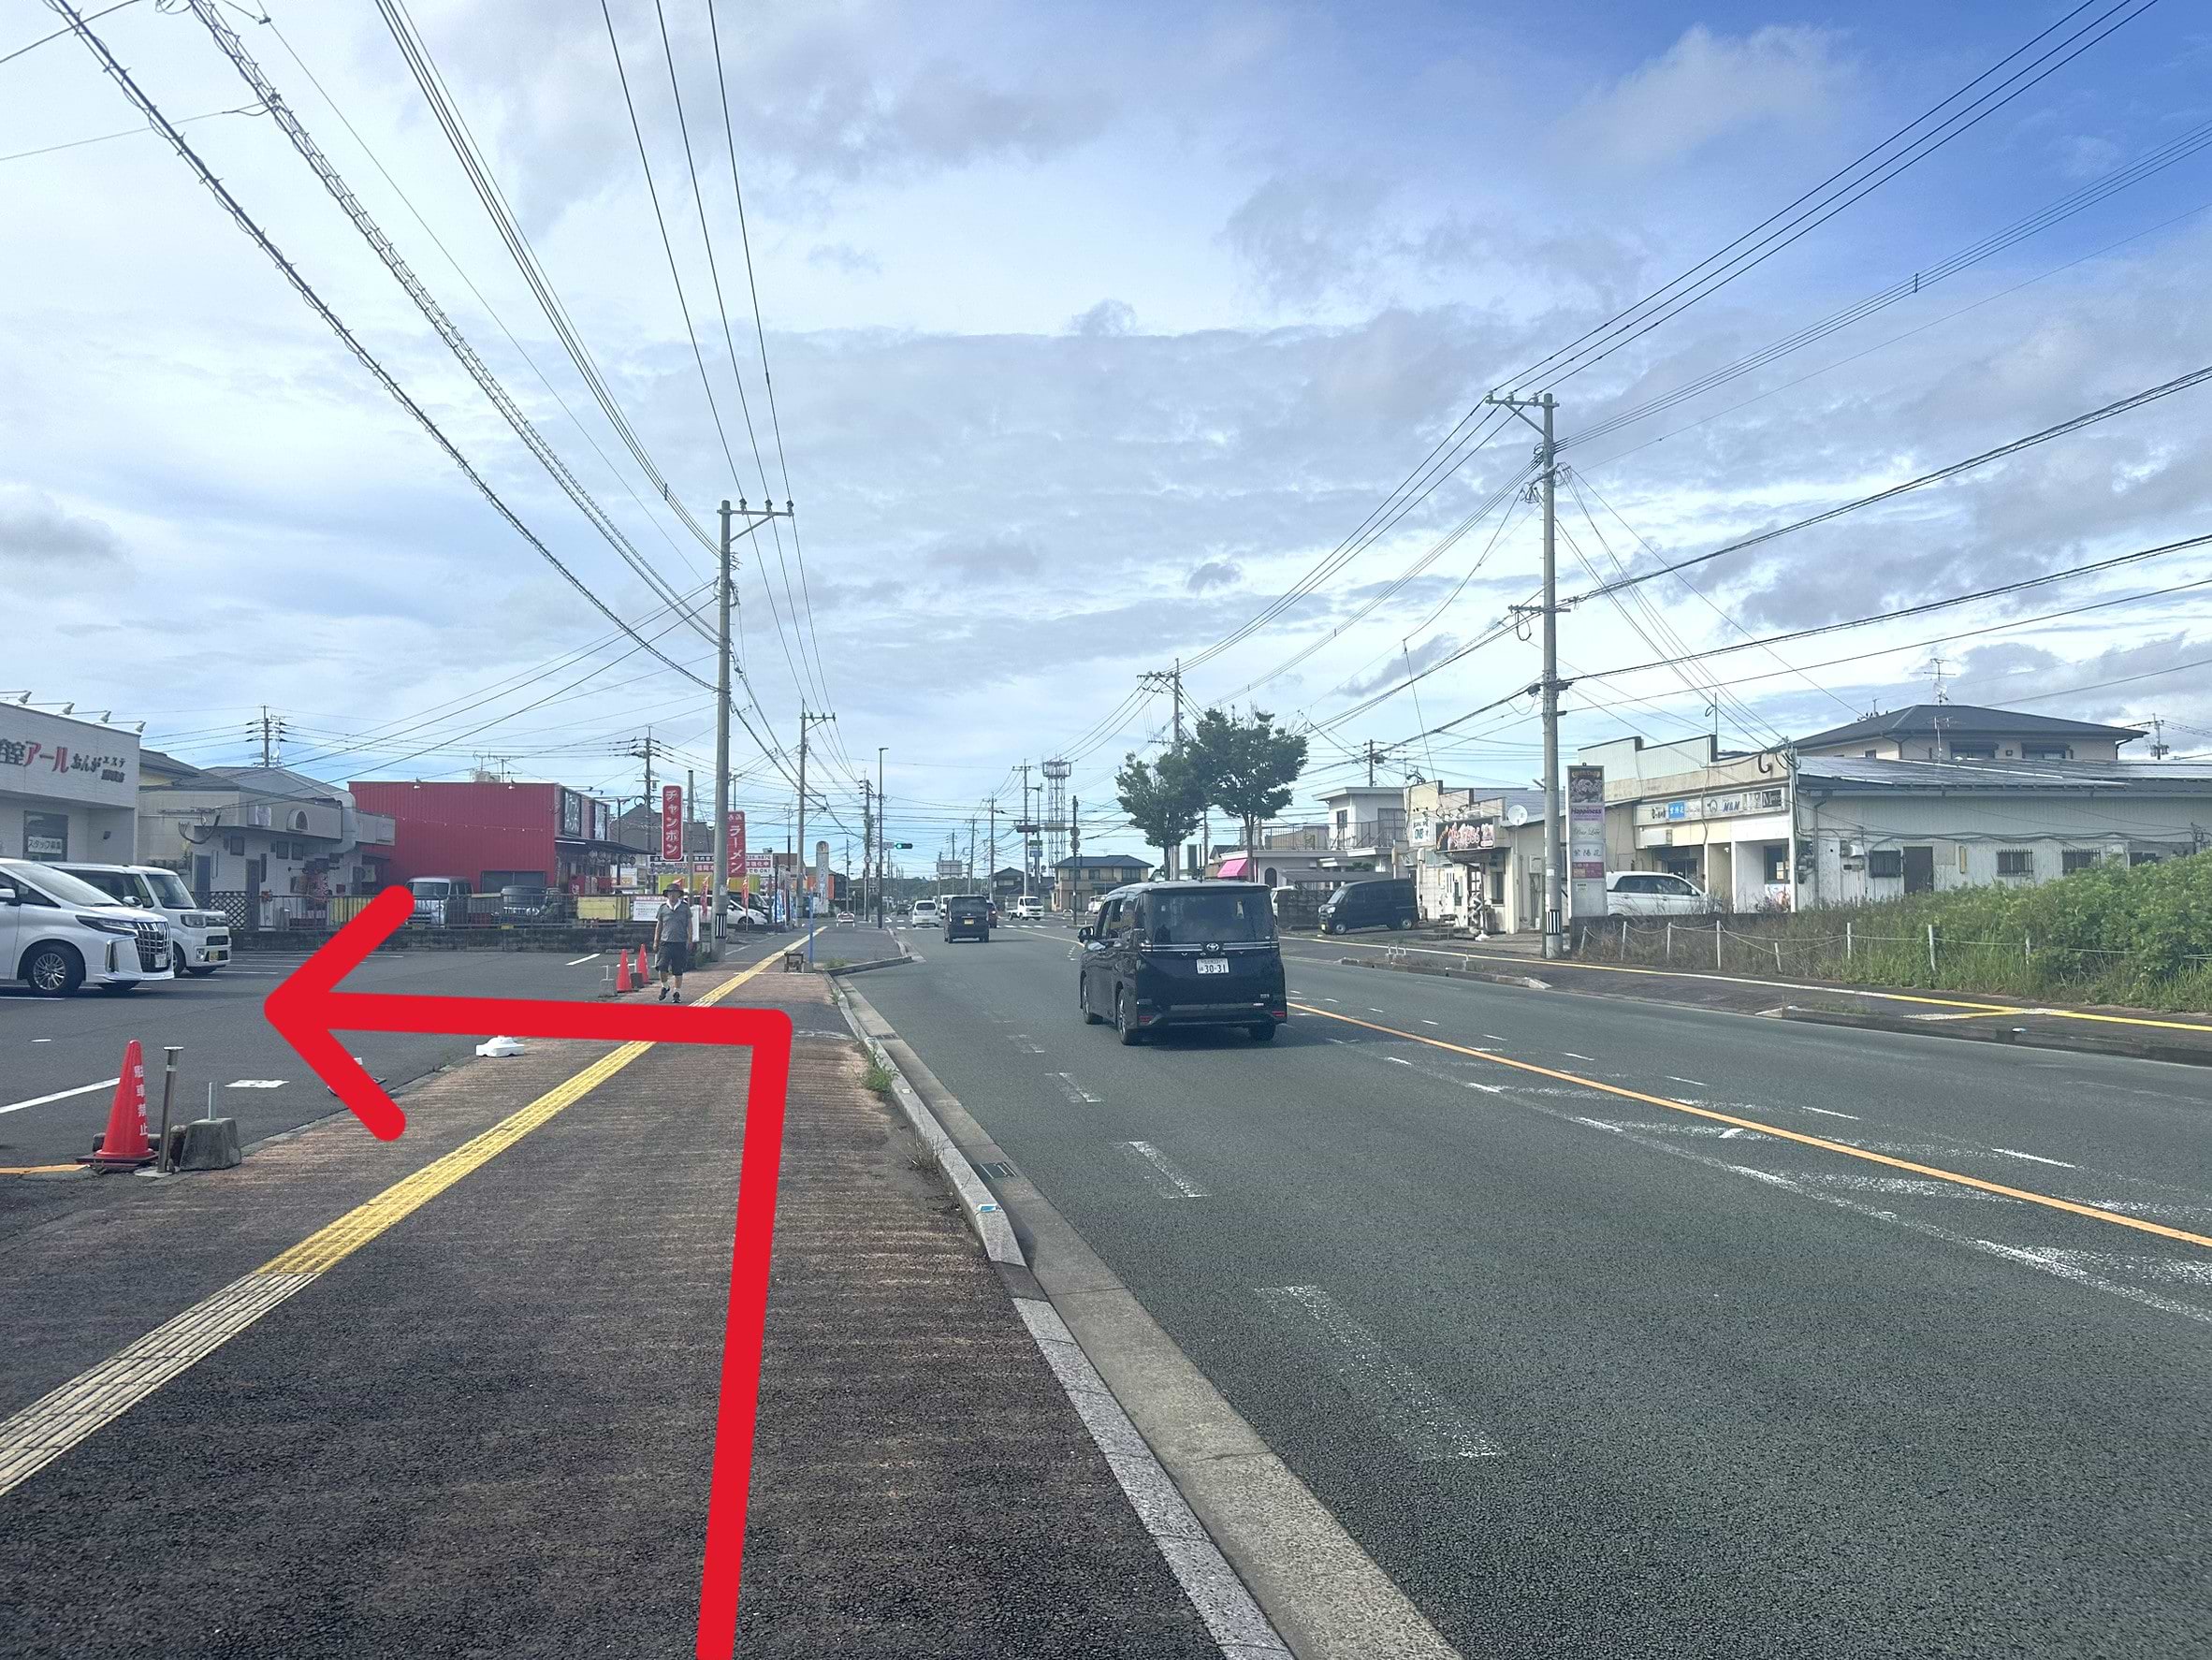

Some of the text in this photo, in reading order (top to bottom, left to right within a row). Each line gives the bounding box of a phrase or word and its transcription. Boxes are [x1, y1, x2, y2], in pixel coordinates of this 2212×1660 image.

[1571, 806, 1602, 815] Happiness
[729, 825, 743, 873] ラーメン
[1204, 964, 1227, 973] 30-31
